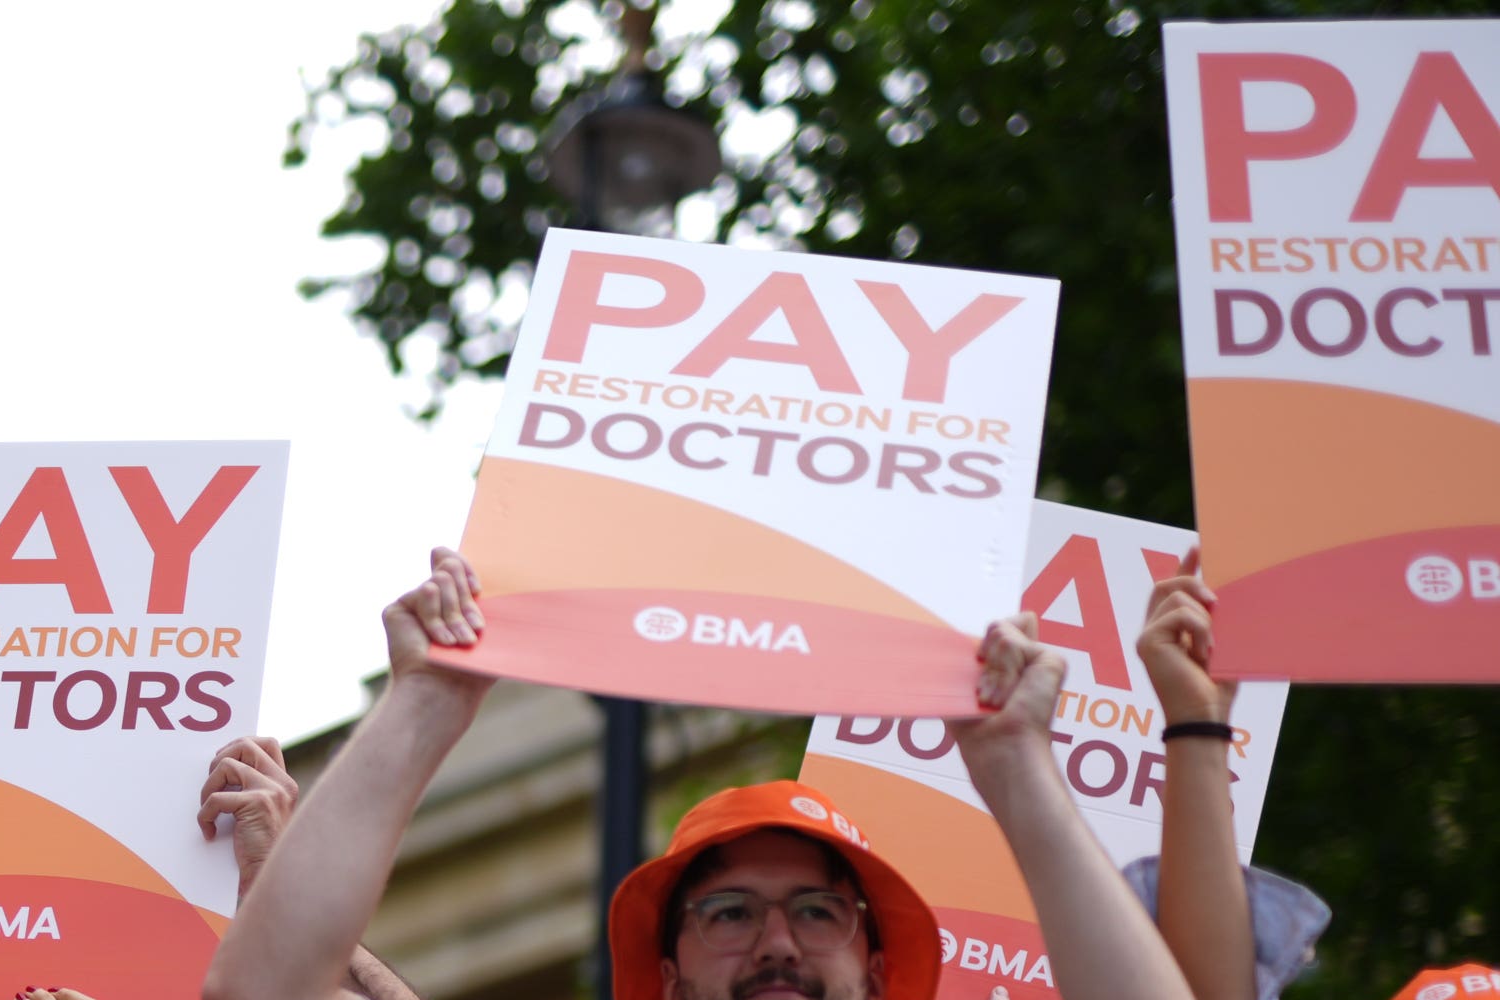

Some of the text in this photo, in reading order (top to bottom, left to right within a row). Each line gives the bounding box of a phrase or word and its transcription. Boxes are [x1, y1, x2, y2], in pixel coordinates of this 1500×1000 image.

[1209, 237, 1500, 273] RESTORAT
[541, 249, 1027, 405] PAY
[532, 369, 1011, 445] RESTORATION FOR
[517, 402, 1005, 499] DOCTORS
[149, 627, 242, 659] FOR
[691, 615, 811, 655] BMA
[960, 937, 1054, 988] BMA
